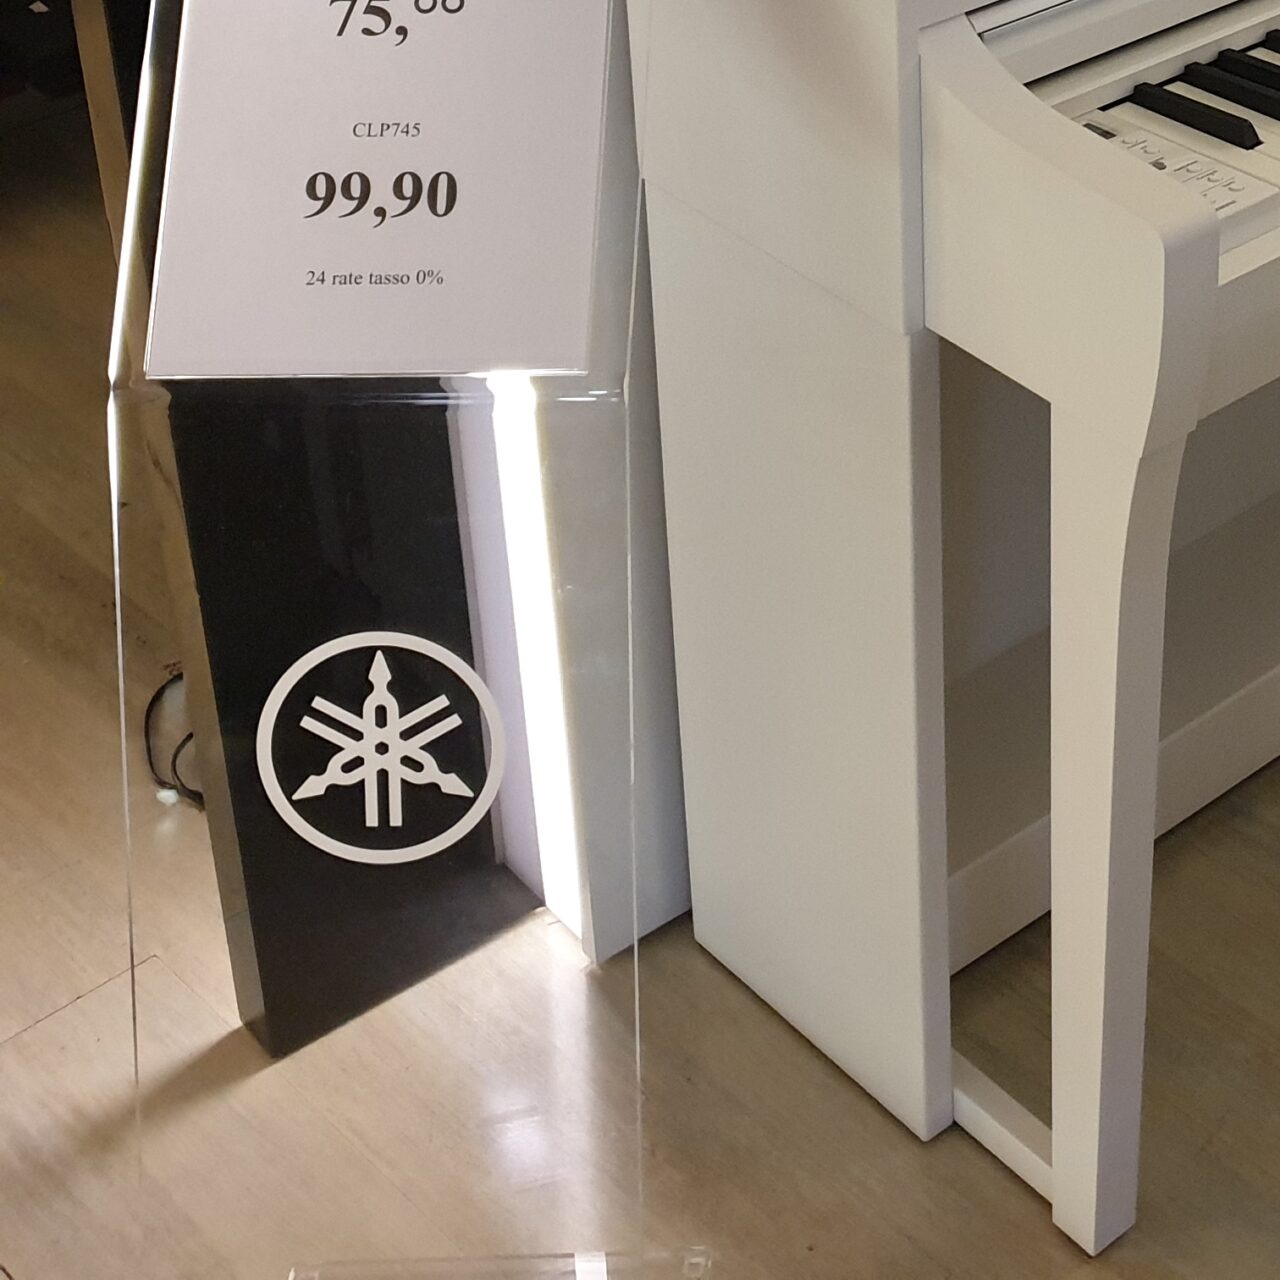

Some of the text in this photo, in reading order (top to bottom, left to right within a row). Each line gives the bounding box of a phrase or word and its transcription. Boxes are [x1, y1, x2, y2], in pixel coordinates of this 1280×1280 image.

[352, 122, 421, 138] CLP745
[303, 170, 458, 229] 99,90
[305, 269, 444, 286] 24 rate tasso 0%
